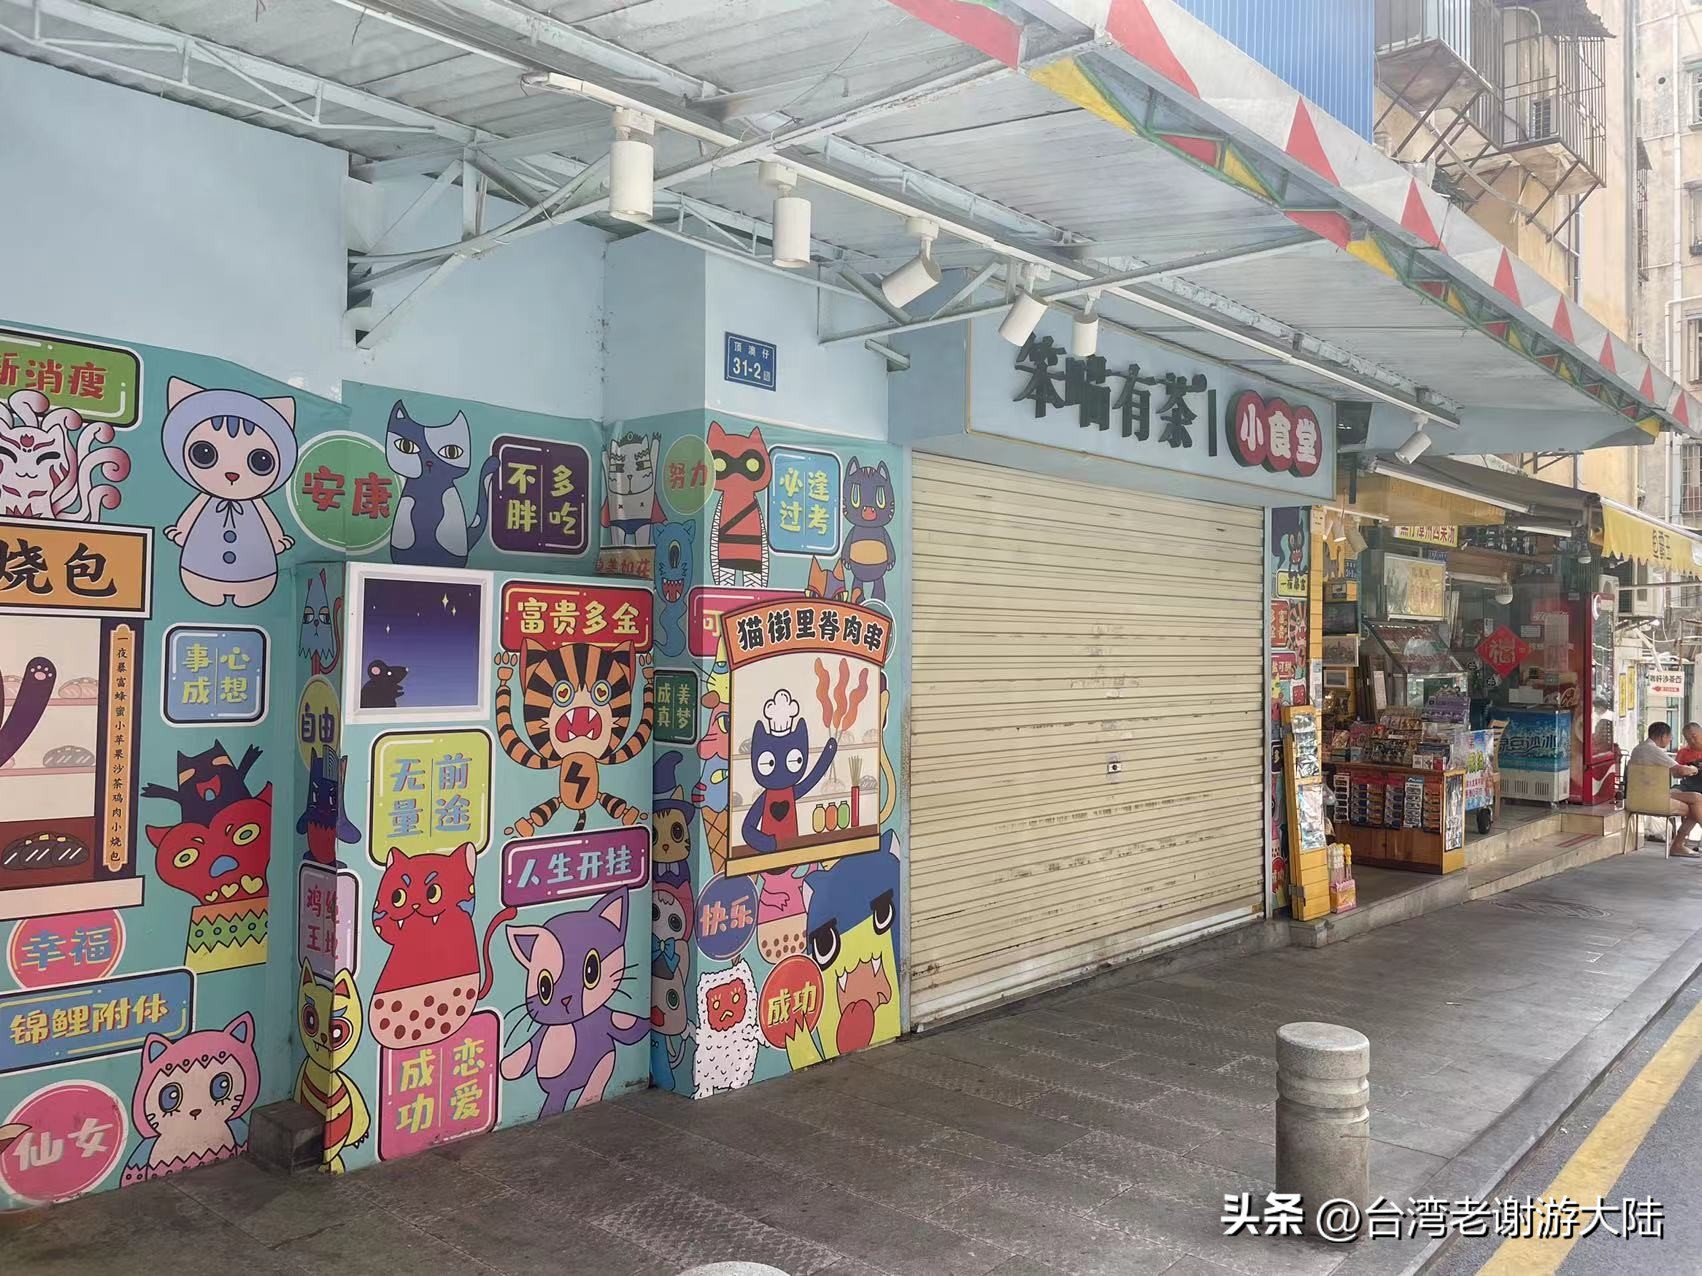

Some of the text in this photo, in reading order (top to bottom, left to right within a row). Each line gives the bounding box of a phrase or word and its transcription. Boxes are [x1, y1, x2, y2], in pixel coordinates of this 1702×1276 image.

[733, 357, 761, 379] 31-2
[1240, 402, 1318, 465] 小食堂
[302, 465, 393, 519] 安康
[667, 461, 709, 491] 努力
[0, 538, 118, 598] 烧包
[517, 597, 641, 636] 富贵多金
[736, 608, 884, 651] 猫街里脊肉串
[1488, 638, 1516, 664] 福
[300, 703, 336, 744] 自由
[109, 635, 129, 862] 一夜暴富蜂蜜小苹果沙茶鸡肉小烧包
[517, 845, 632, 887] 人生开挂
[699, 895, 754, 938] 快乐
[21, 926, 113, 972] 幸福
[9, 993, 170, 1044] 锦鲤附体
[767, 981, 818, 1028] 成功
[12, 1117, 114, 1172] 仙女
